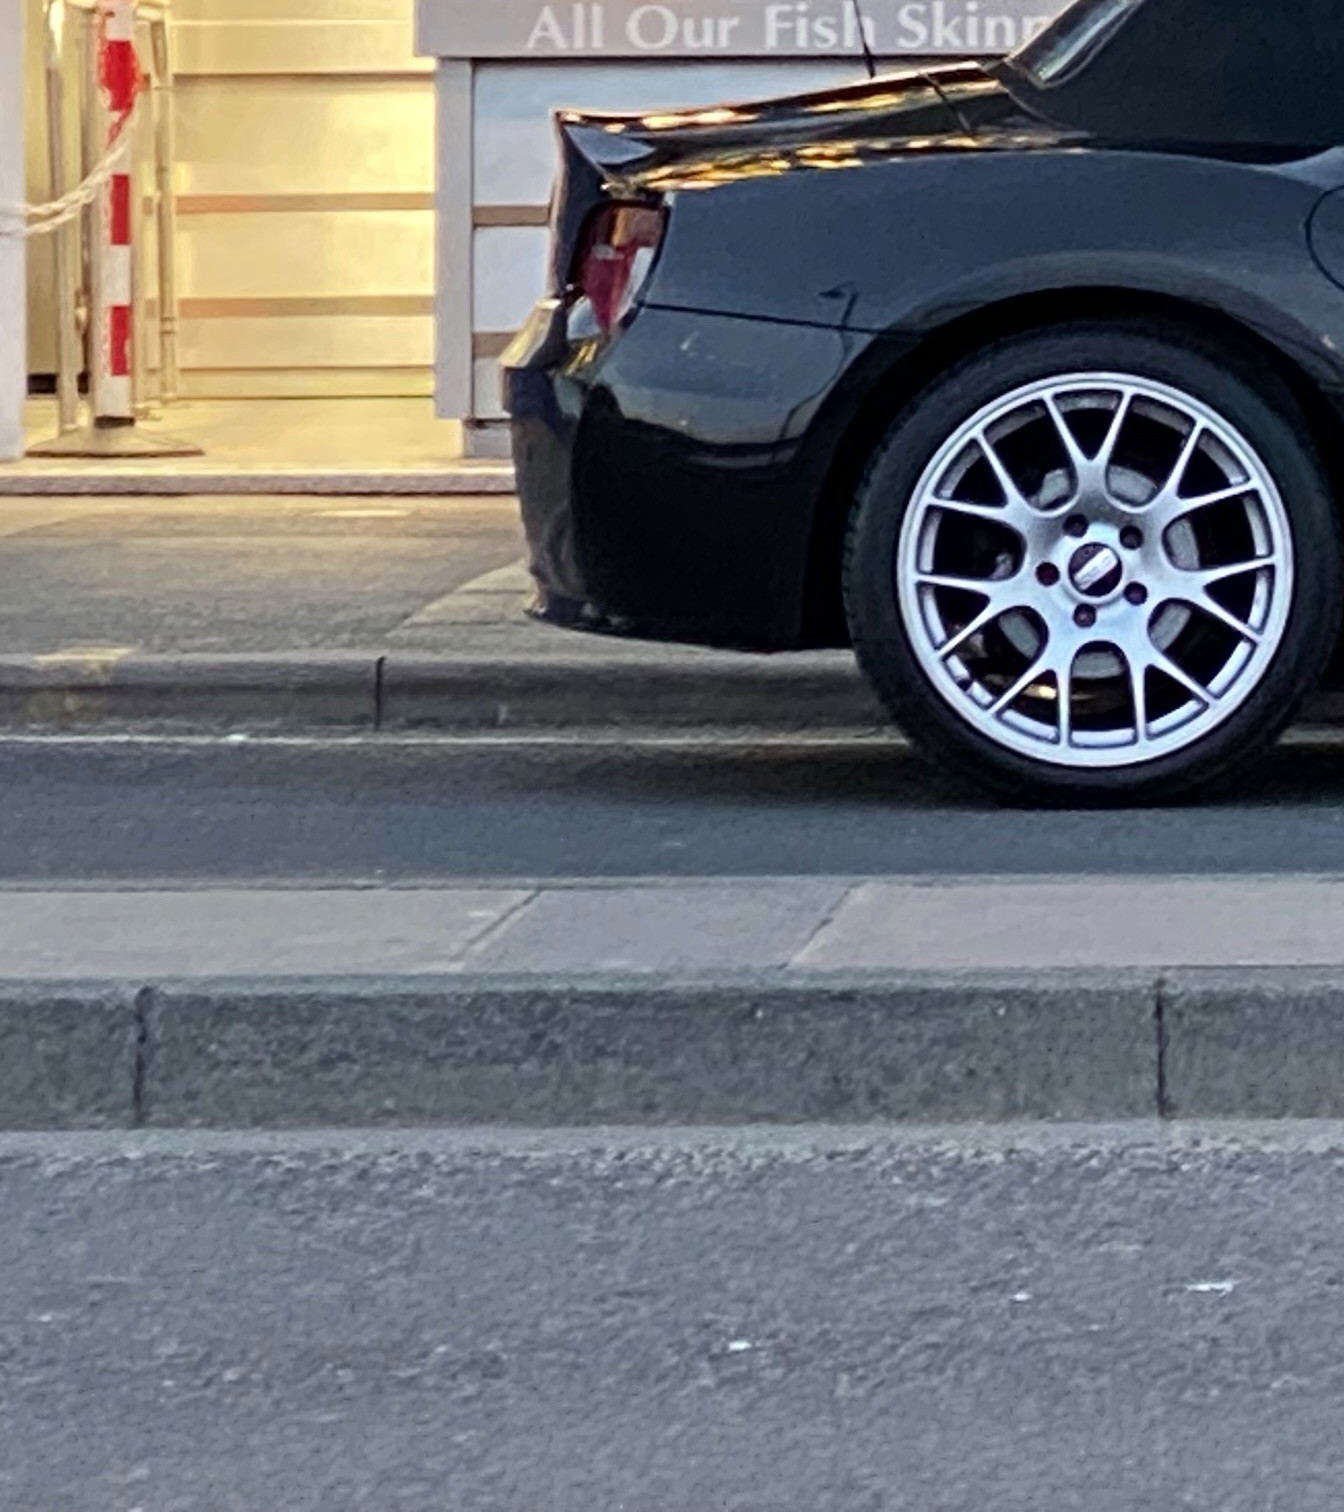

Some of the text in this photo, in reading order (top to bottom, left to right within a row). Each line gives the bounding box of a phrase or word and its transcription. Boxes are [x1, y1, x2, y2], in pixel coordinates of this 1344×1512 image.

[526, 2, 603, 49] All
[626, 4, 740, 50] Our
[764, 0, 877, 49] Fish
